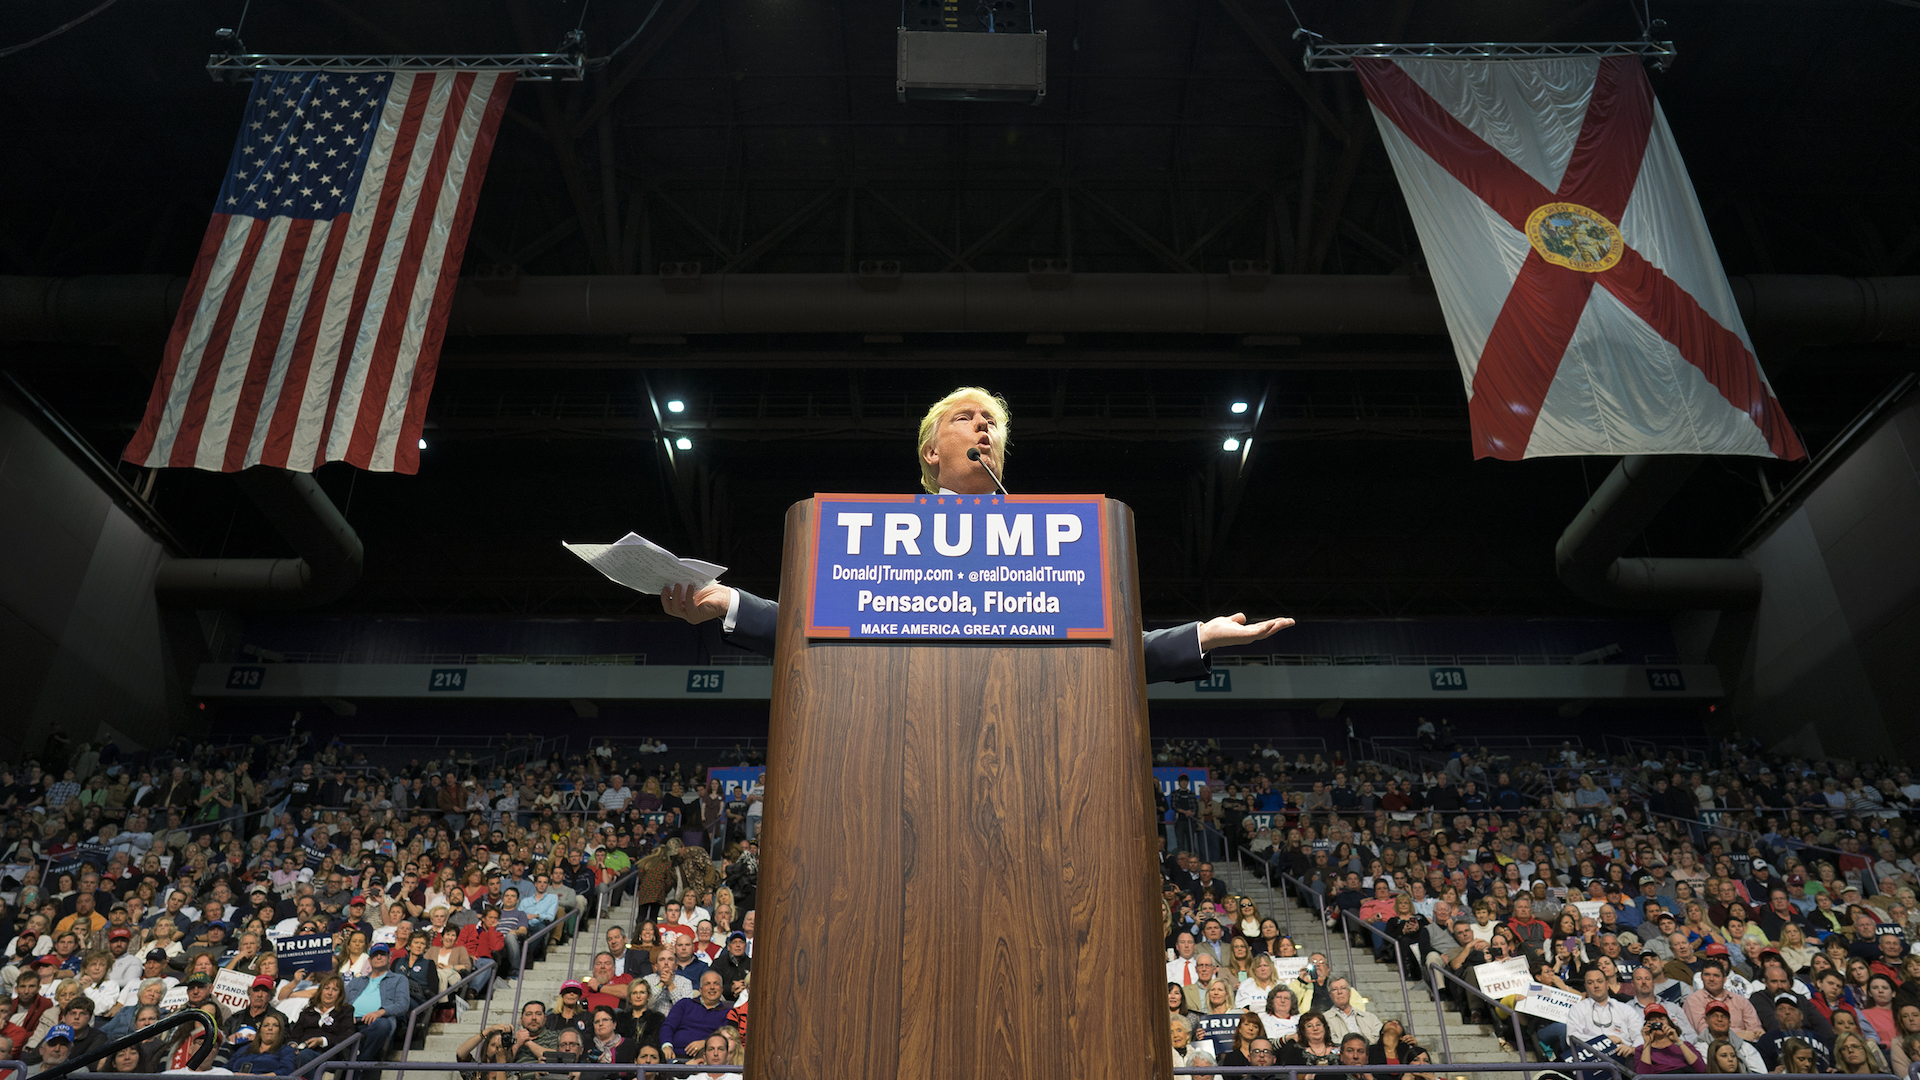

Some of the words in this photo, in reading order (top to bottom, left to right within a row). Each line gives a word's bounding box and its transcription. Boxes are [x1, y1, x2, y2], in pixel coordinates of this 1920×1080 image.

[837, 512, 1083, 557] TRUMP
[832, 564, 953, 584] DonaldJTrump.com
[968, 566, 1085, 585] @realDonaldTrump
[857, 590, 977, 615] Pensacola,
[984, 590, 1060, 613] Florida
[861, 623, 898, 635] MAKE
[900, 623, 960, 635] AMERICA
[963, 624, 1006, 635] GREAT
[1009, 624, 1055, 636] AGAIN!
[231, 670, 260, 685] 213
[433, 672, 461, 686] 214
[691, 674, 720, 688] 215
[1434, 671, 1463, 686] 218
[277, 937, 332, 951] TRUMP
[1550, 990, 1580, 1001] VETERANS
